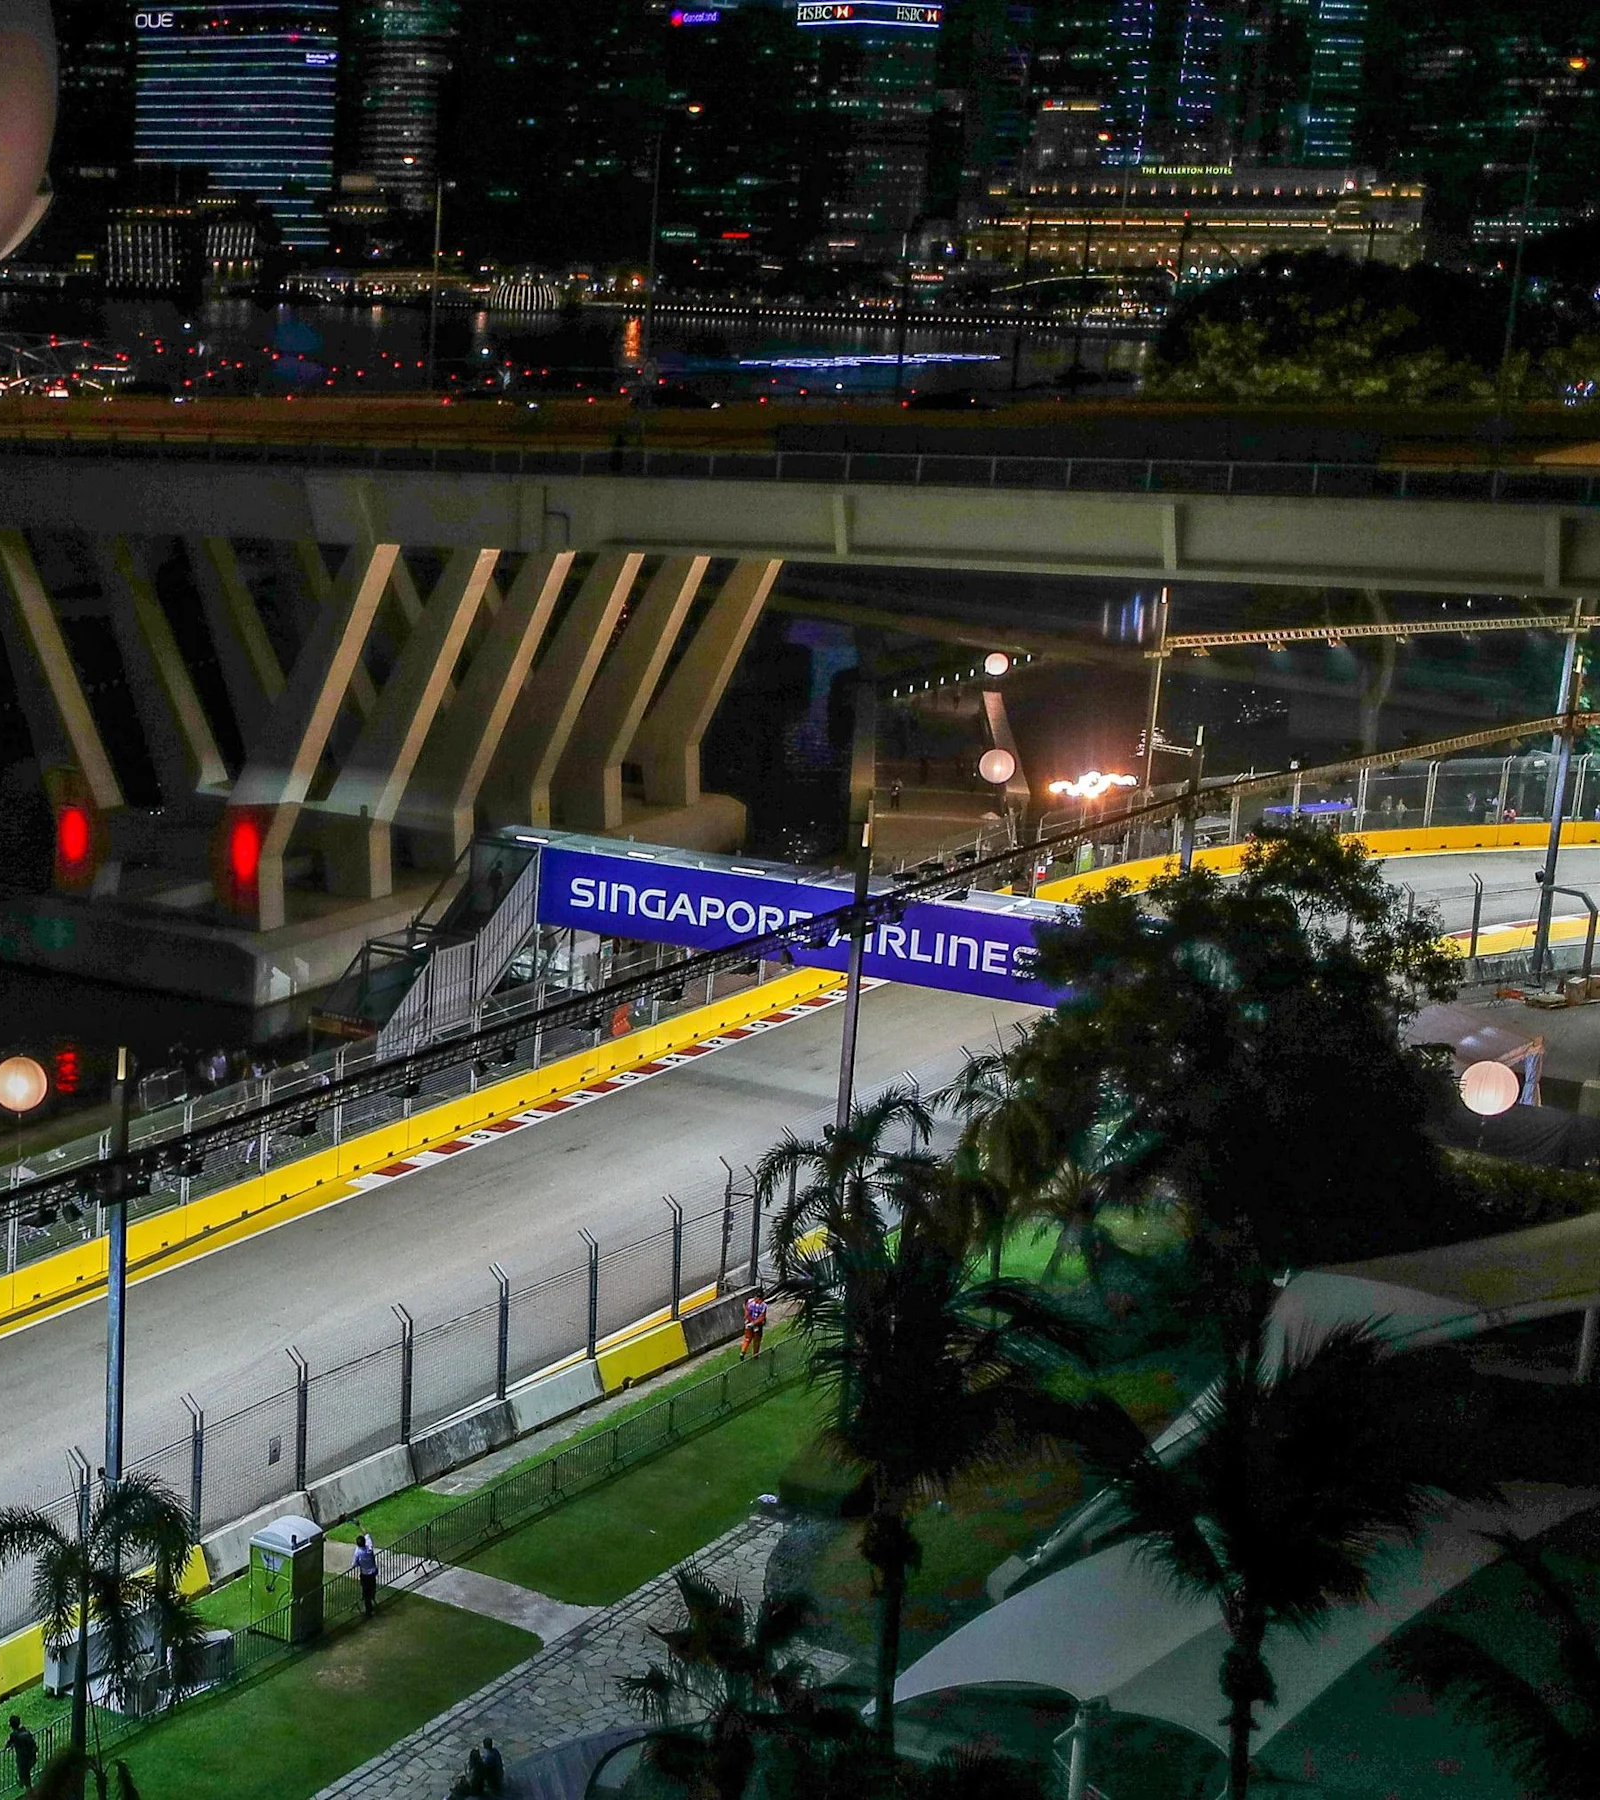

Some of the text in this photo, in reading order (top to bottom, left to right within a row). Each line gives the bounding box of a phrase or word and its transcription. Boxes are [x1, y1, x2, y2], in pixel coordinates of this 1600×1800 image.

[135, 12, 175, 28] OUE
[796, 6, 832, 20] HSBC
[896, 7, 924, 22] HSBC
[1142, 166, 1156, 175] THE
[1206, 165, 1233, 175] HOTEL
[569, 877, 814, 944] SINGAPORE
